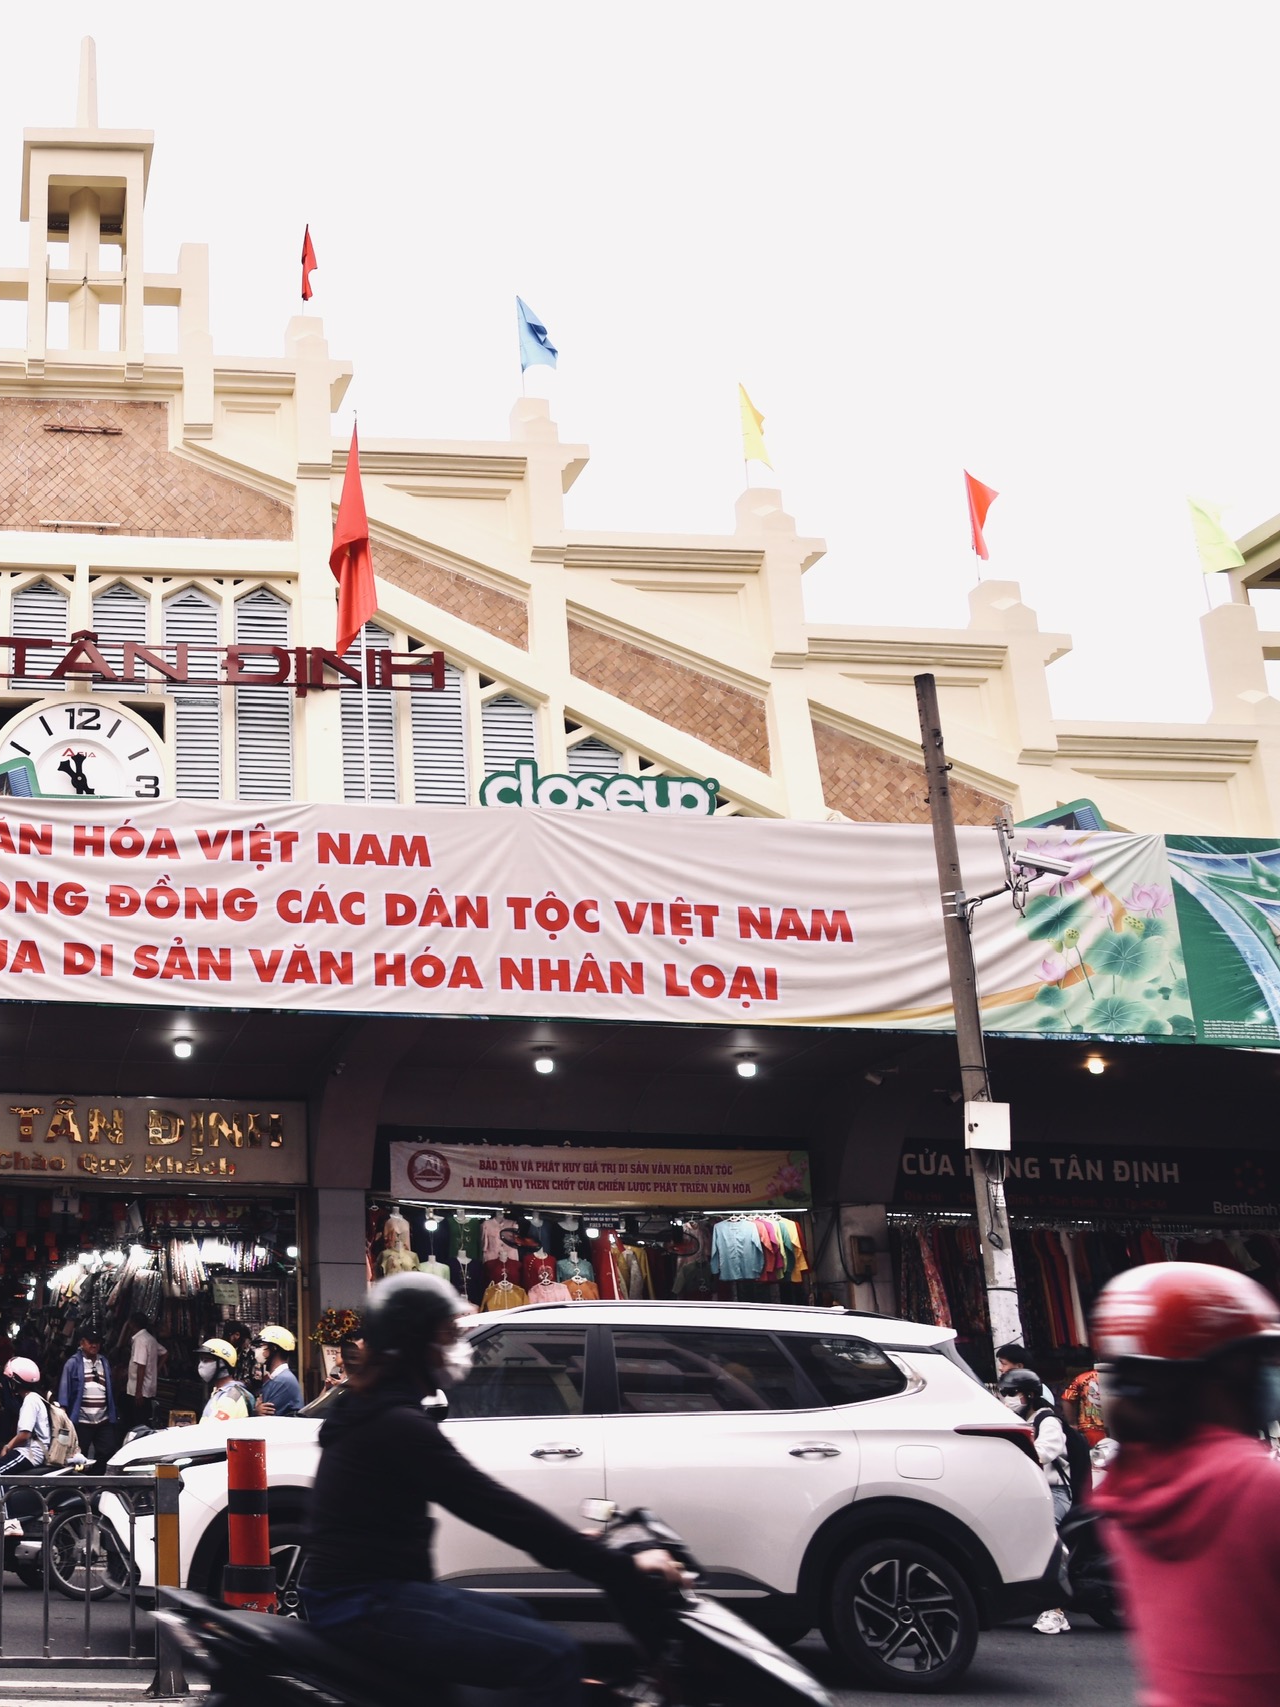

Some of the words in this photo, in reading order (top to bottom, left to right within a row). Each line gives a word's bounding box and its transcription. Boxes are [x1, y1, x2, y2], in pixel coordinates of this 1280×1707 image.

[221, 644, 445, 698] ĐỊNH
[65, 708, 101, 731] 12
[135, 775, 160, 798] 3
[484, 764, 710, 815] closeup
[73, 818, 181, 860] HÓA
[194, 822, 299, 872] VIỆT
[318, 832, 431, 868] NAM
[105, 874, 258, 922] ĐỒNG
[276, 883, 366, 926] CÁC
[385, 888, 489, 929] DÂN
[506, 891, 600, 941] TỘC
[614, 897, 719, 946] VIỆT
[737, 906, 854, 943] NAM
[62, 943, 114, 977] DI
[132, 936, 232, 982] SẢN
[249, 943, 354, 986] VĂN
[374, 946, 484, 989] HÓA
[499, 952, 645, 996] NHÂN
[664, 963, 779, 1009] LOẠI
[9, 1097, 124, 1145] TÂN
[145, 1108, 283, 1156] ĐỊNH
[77, 1152, 134, 1176] Quý
[144, 1154, 236, 1176] Khách
[463, 1176, 475, 1188] LÀ
[477, 1177, 508, 1190] NHIỆM
[510, 1179, 523, 1191] VỤ
[524, 1179, 550, 1190] THEN
[551, 1175, 576, 1191] CHỐT
[577, 1177, 596, 1191] CỦA
[597, 1177, 625, 1192] CHIẾN
[627, 1180, 651, 1194] LƯỢC
[653, 1180, 677, 1193] PHÁT
[680, 1178, 709, 1193] TRIỂN
[710, 1180, 731, 1194] VĂN
[732, 1180, 751, 1194] HÓA
[479, 1157, 498, 1171] BẢO
[500, 1157, 520, 1172] TỒN
[521, 1159, 534, 1172] VÀ
[536, 1159, 560, 1173] PHÁT
[562, 1162, 581, 1173] HUY
[583, 1160, 599, 1174] GIÁ
[600, 1162, 616, 1175] TRỊ
[618, 1163, 628, 1174] DI
[630, 1160, 649, 1174] SẢN
[651, 1162, 670, 1175] VĂN
[673, 1161, 692, 1175] HÓA
[694, 1161, 713, 1175] DÂN
[902, 1148, 955, 1176] CỬA
[965, 1154, 1041, 1179] HNG
[1049, 1154, 1104, 1182] TÂN
[1112, 1160, 1180, 1189] ĐỊNH
[1213, 1201, 1280, 1216] Benthanh
